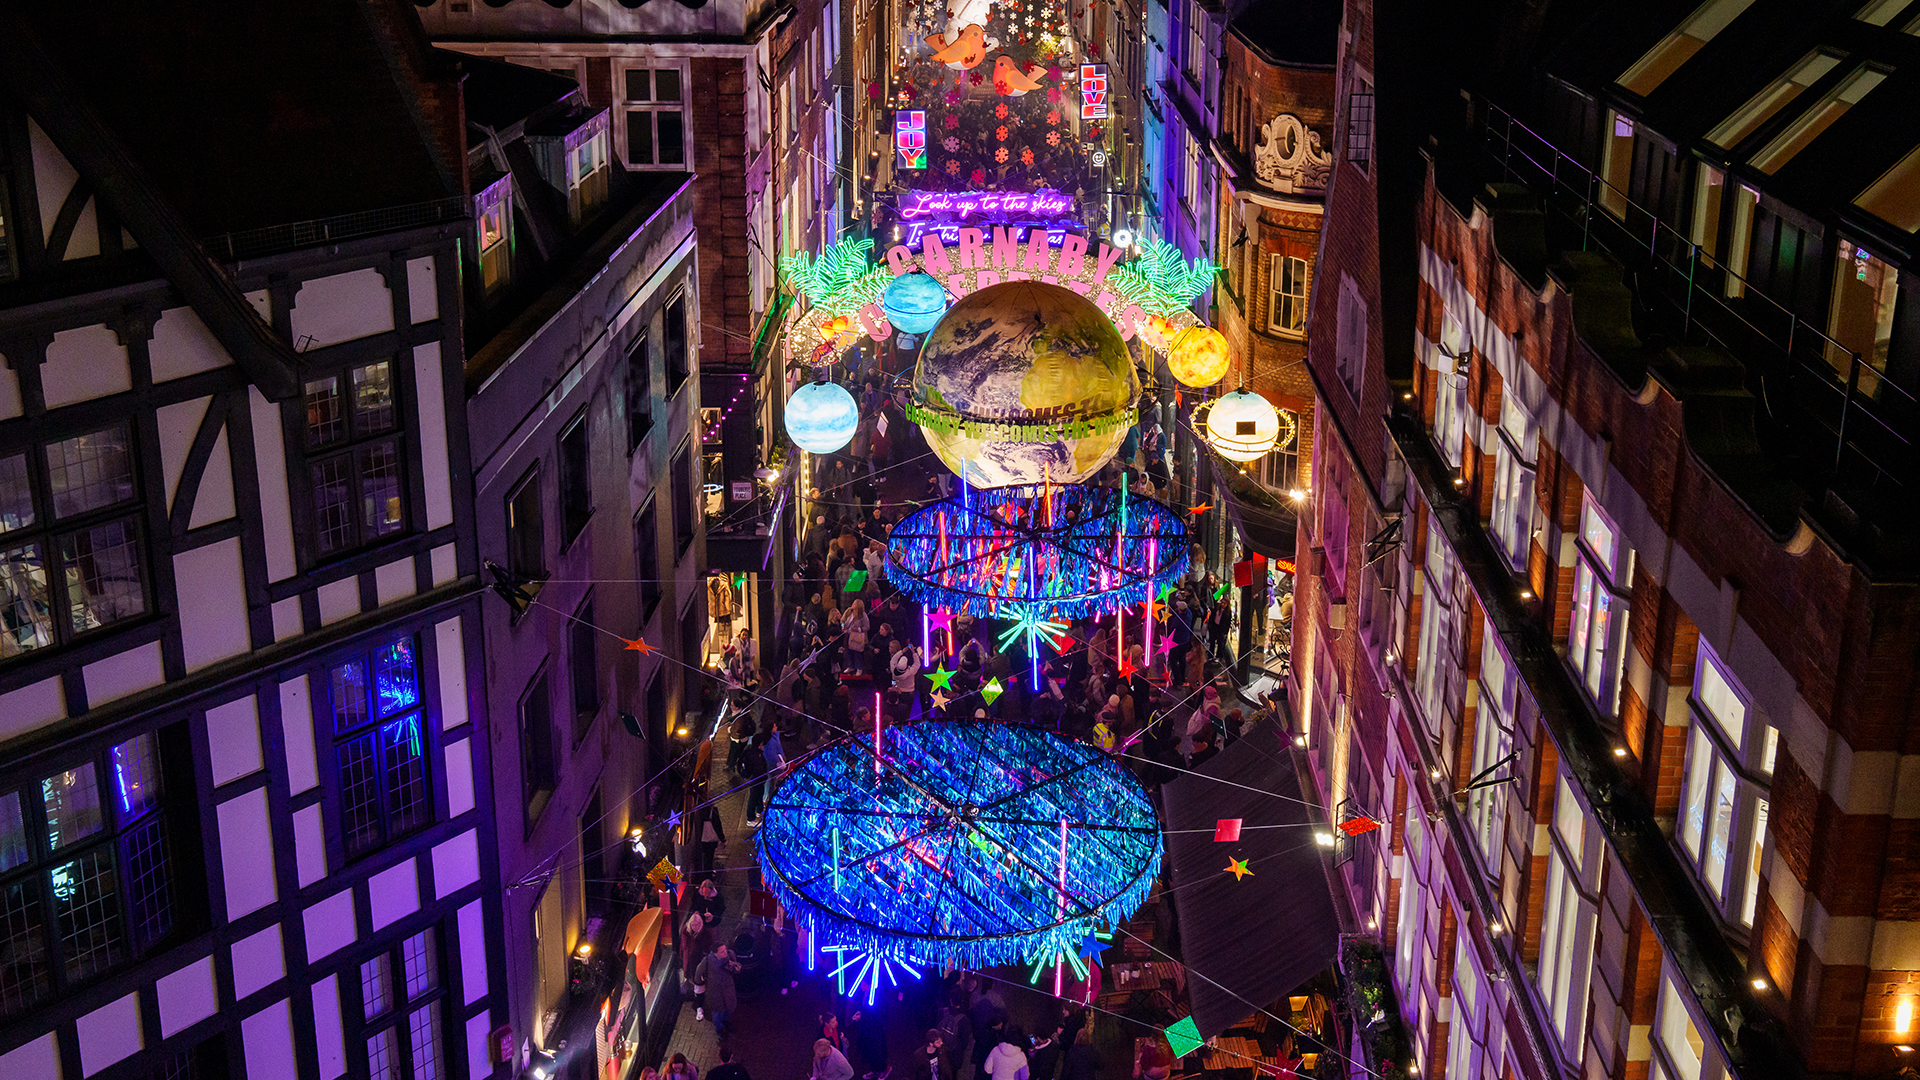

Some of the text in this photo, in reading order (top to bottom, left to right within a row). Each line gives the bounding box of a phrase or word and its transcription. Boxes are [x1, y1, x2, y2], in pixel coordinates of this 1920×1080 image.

[1081, 65, 1107, 118] LOVE
[897, 111, 925, 168] JOY
[902, 194, 952, 218] Look
[956, 202, 978, 217] up
[979, 194, 999, 209] to
[1000, 195, 1028, 210] the
[1030, 195, 1067, 213] skies
[887, 227, 1124, 285] CARNABY
[905, 402, 1140, 443] CARNABY WELCOMES THE WORLD
